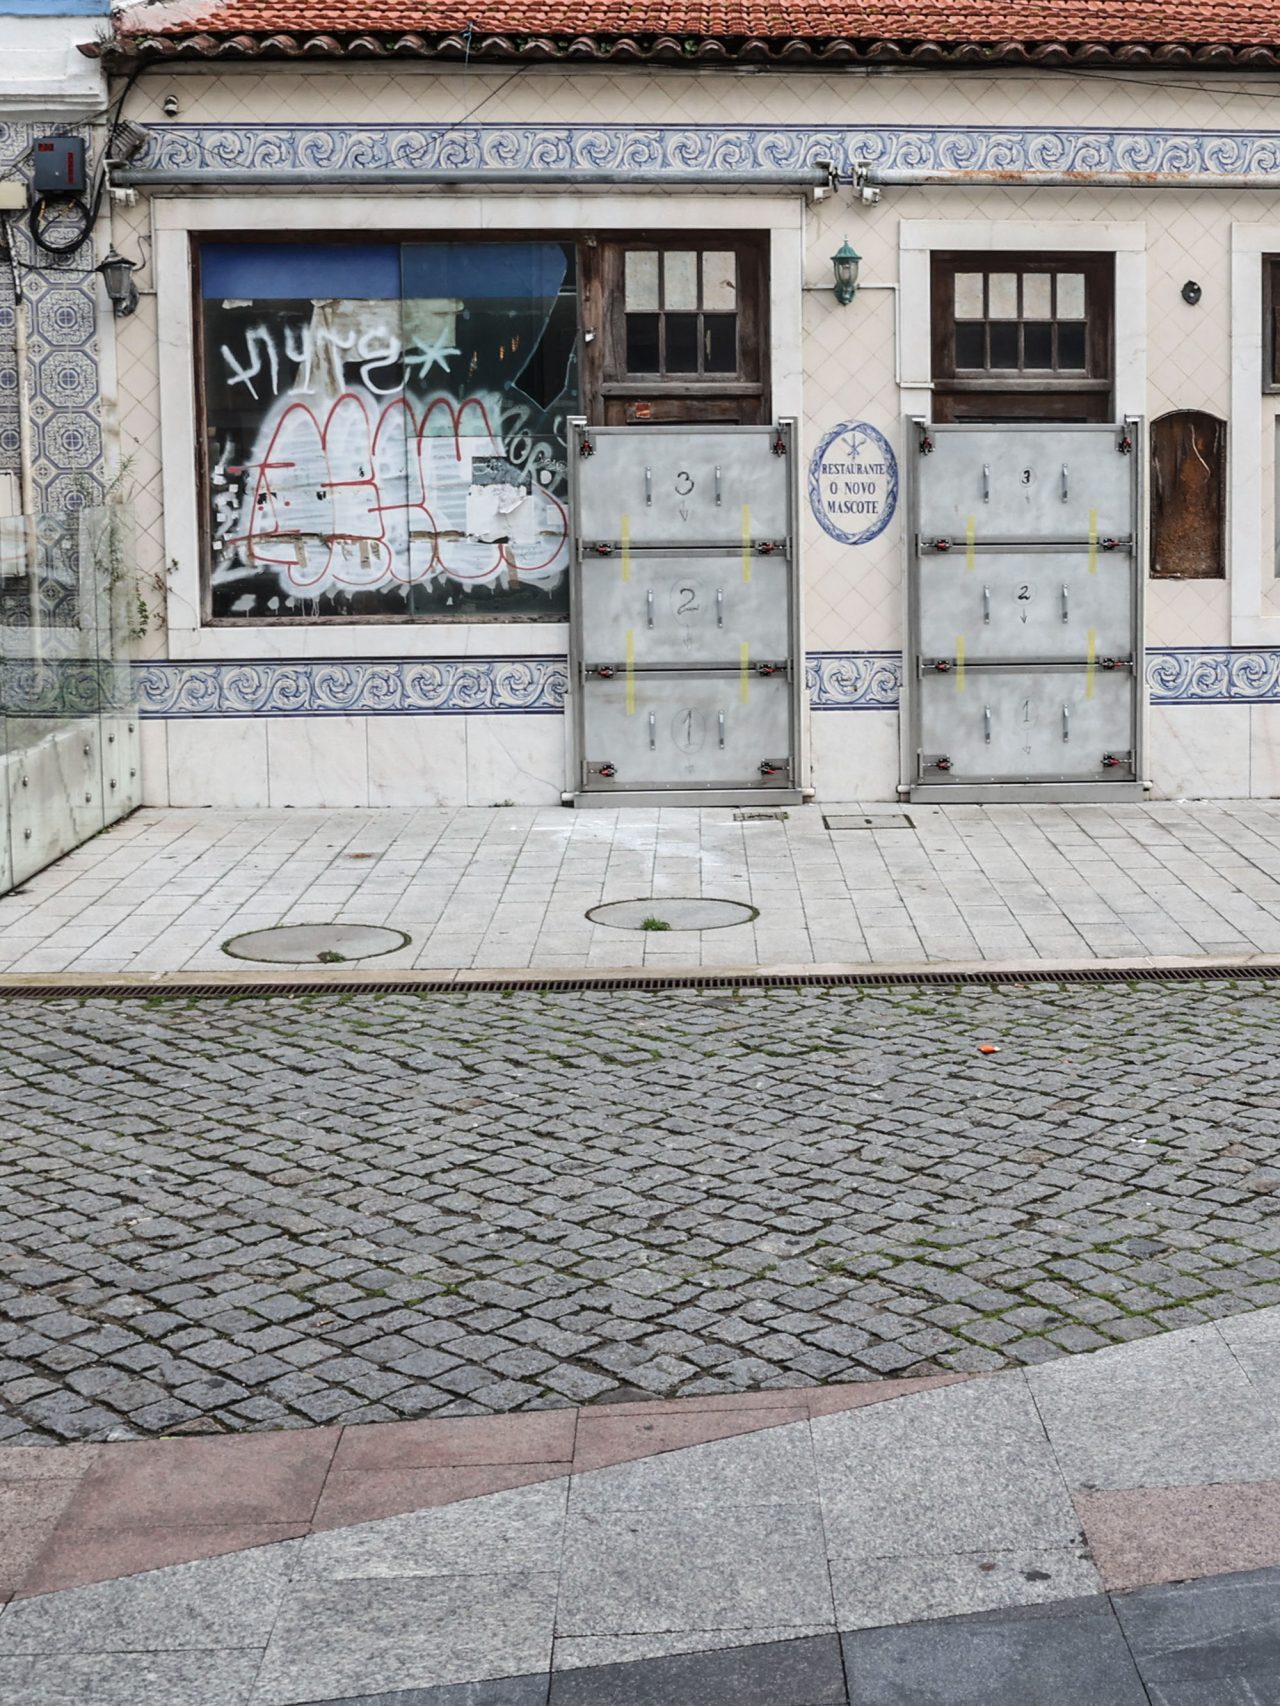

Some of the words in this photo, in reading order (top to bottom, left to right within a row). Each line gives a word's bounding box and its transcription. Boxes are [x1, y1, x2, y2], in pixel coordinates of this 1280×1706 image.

[821, 463, 886, 475] RESTAURANTE
[1020, 469, 1031, 485] 3
[674, 471, 695, 496] 3
[829, 481, 839, 495] O
[845, 481, 876, 495] NOVO
[827, 500, 879, 514] MASCOTE
[1017, 585, 1032, 601] 2
[676, 588, 700, 615] 2
